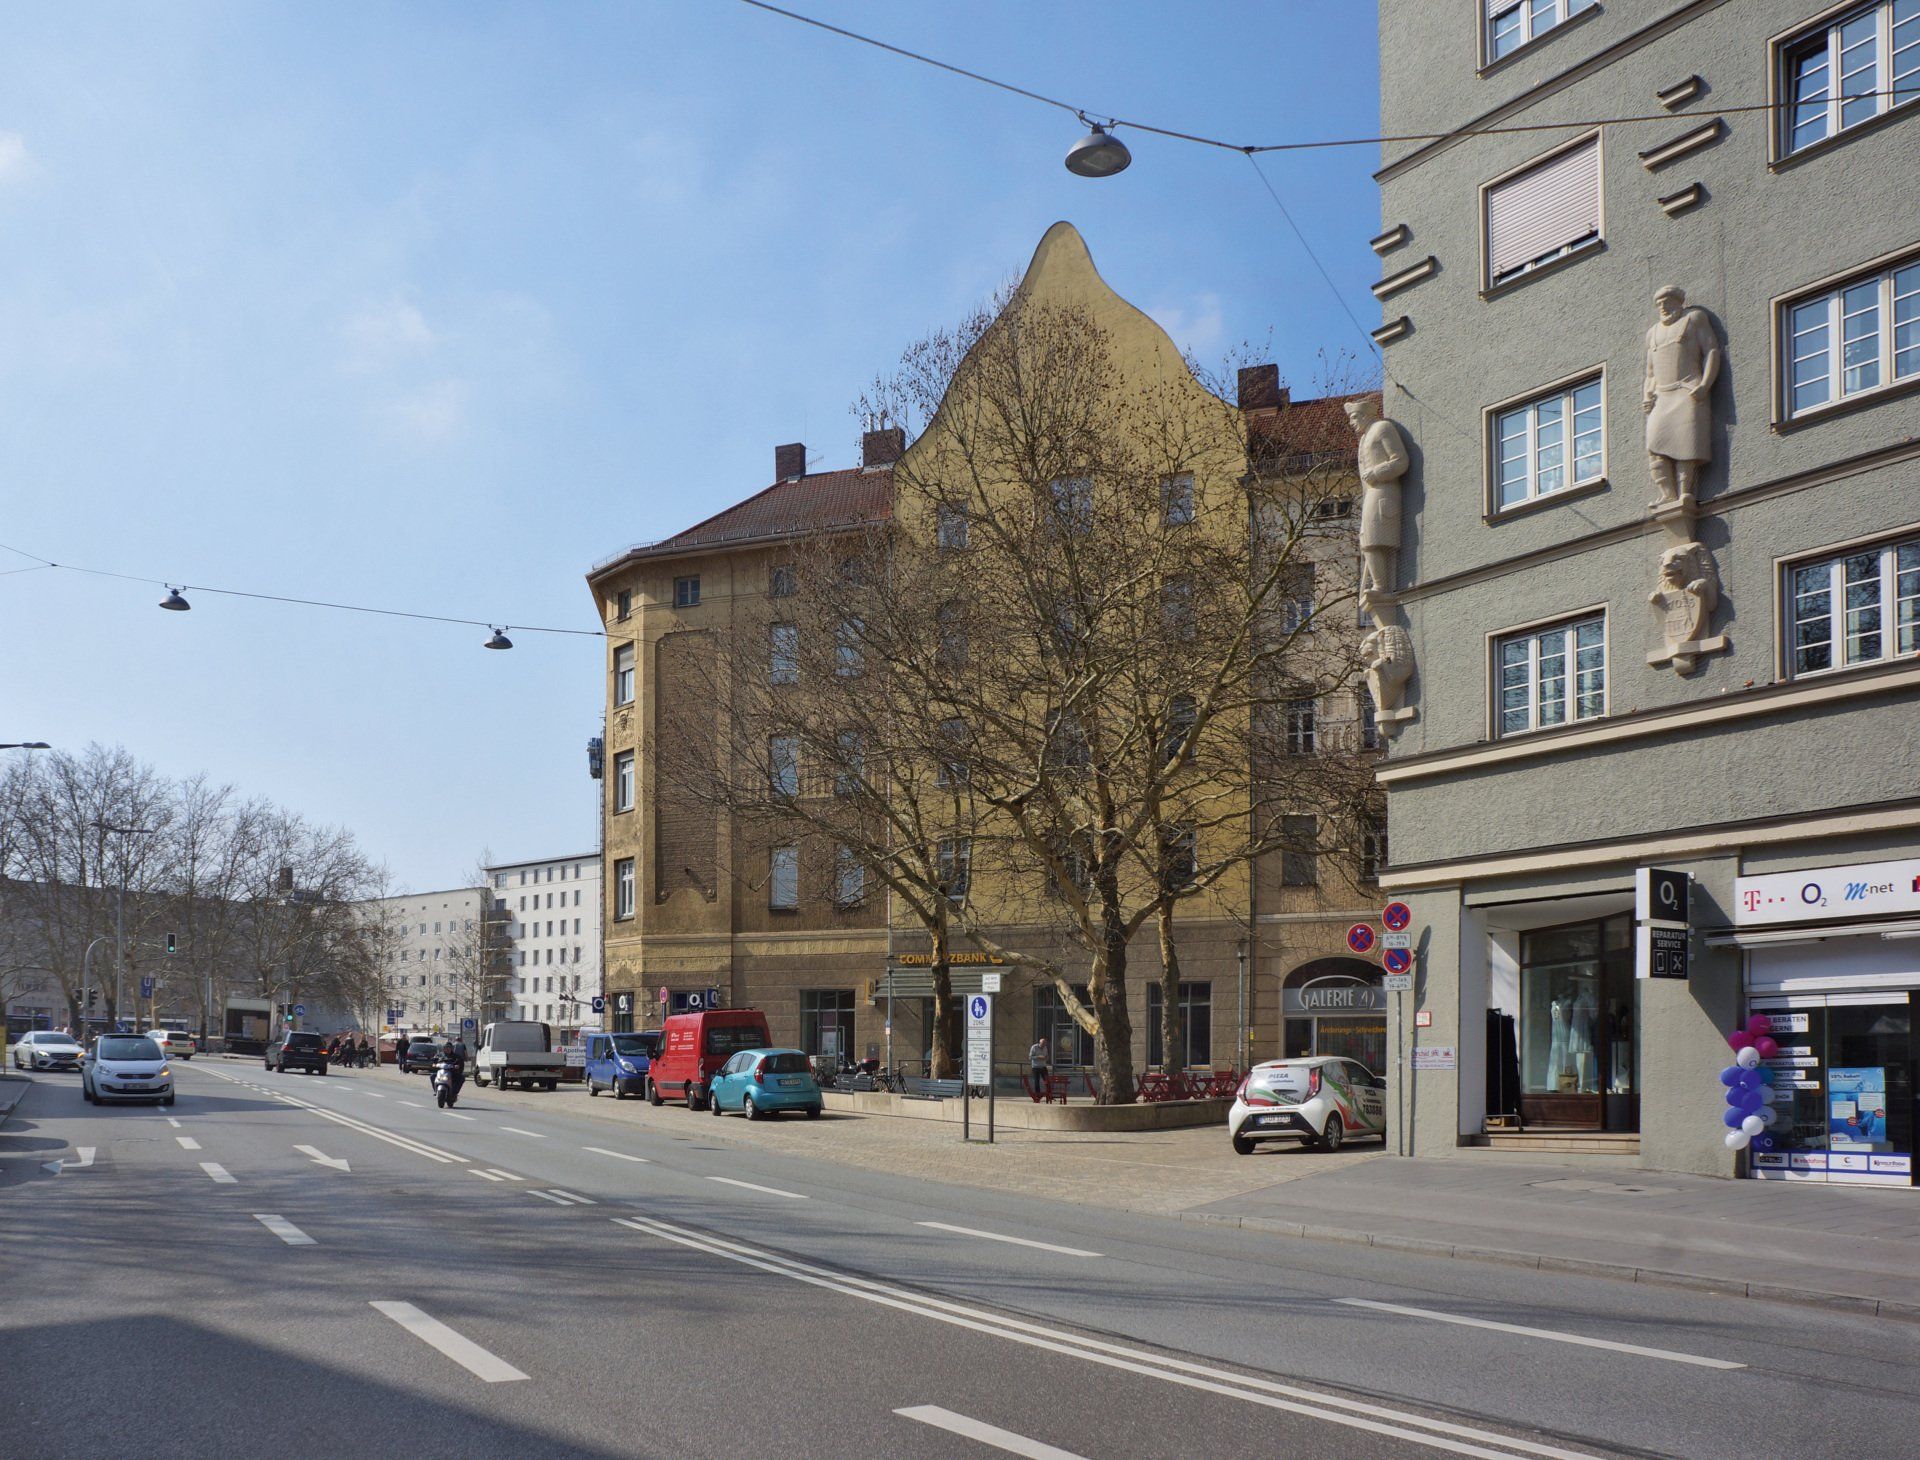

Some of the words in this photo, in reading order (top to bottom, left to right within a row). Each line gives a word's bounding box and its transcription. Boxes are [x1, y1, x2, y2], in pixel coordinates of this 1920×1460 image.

[1652, 930, 1686, 940] REPARATUR
[1657, 939, 1681, 949] SERVICE
[900, 952, 987, 965] COMMZBANK
